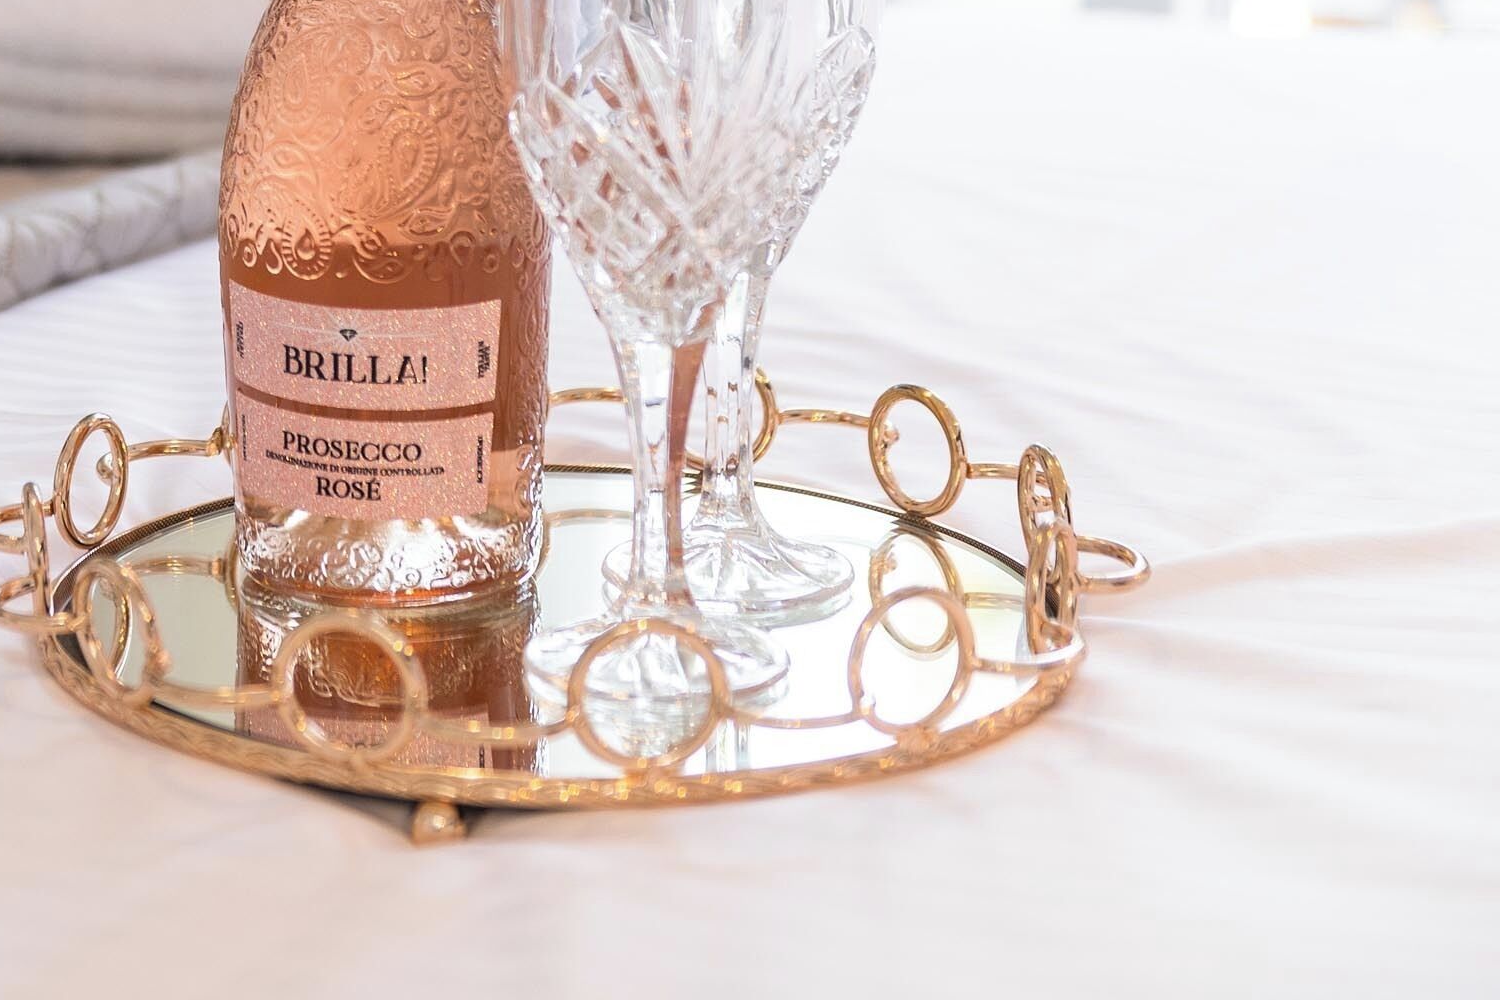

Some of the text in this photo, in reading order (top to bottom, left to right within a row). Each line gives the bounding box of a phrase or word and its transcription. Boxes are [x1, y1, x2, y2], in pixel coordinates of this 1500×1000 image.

[282, 343, 428, 385] BRILLA!
[282, 430, 422, 462] PROSECCO
[330, 464, 340, 473] DI
[381, 466, 445, 477] CONTROLLATA
[315, 476, 381, 501] ROSÉ
